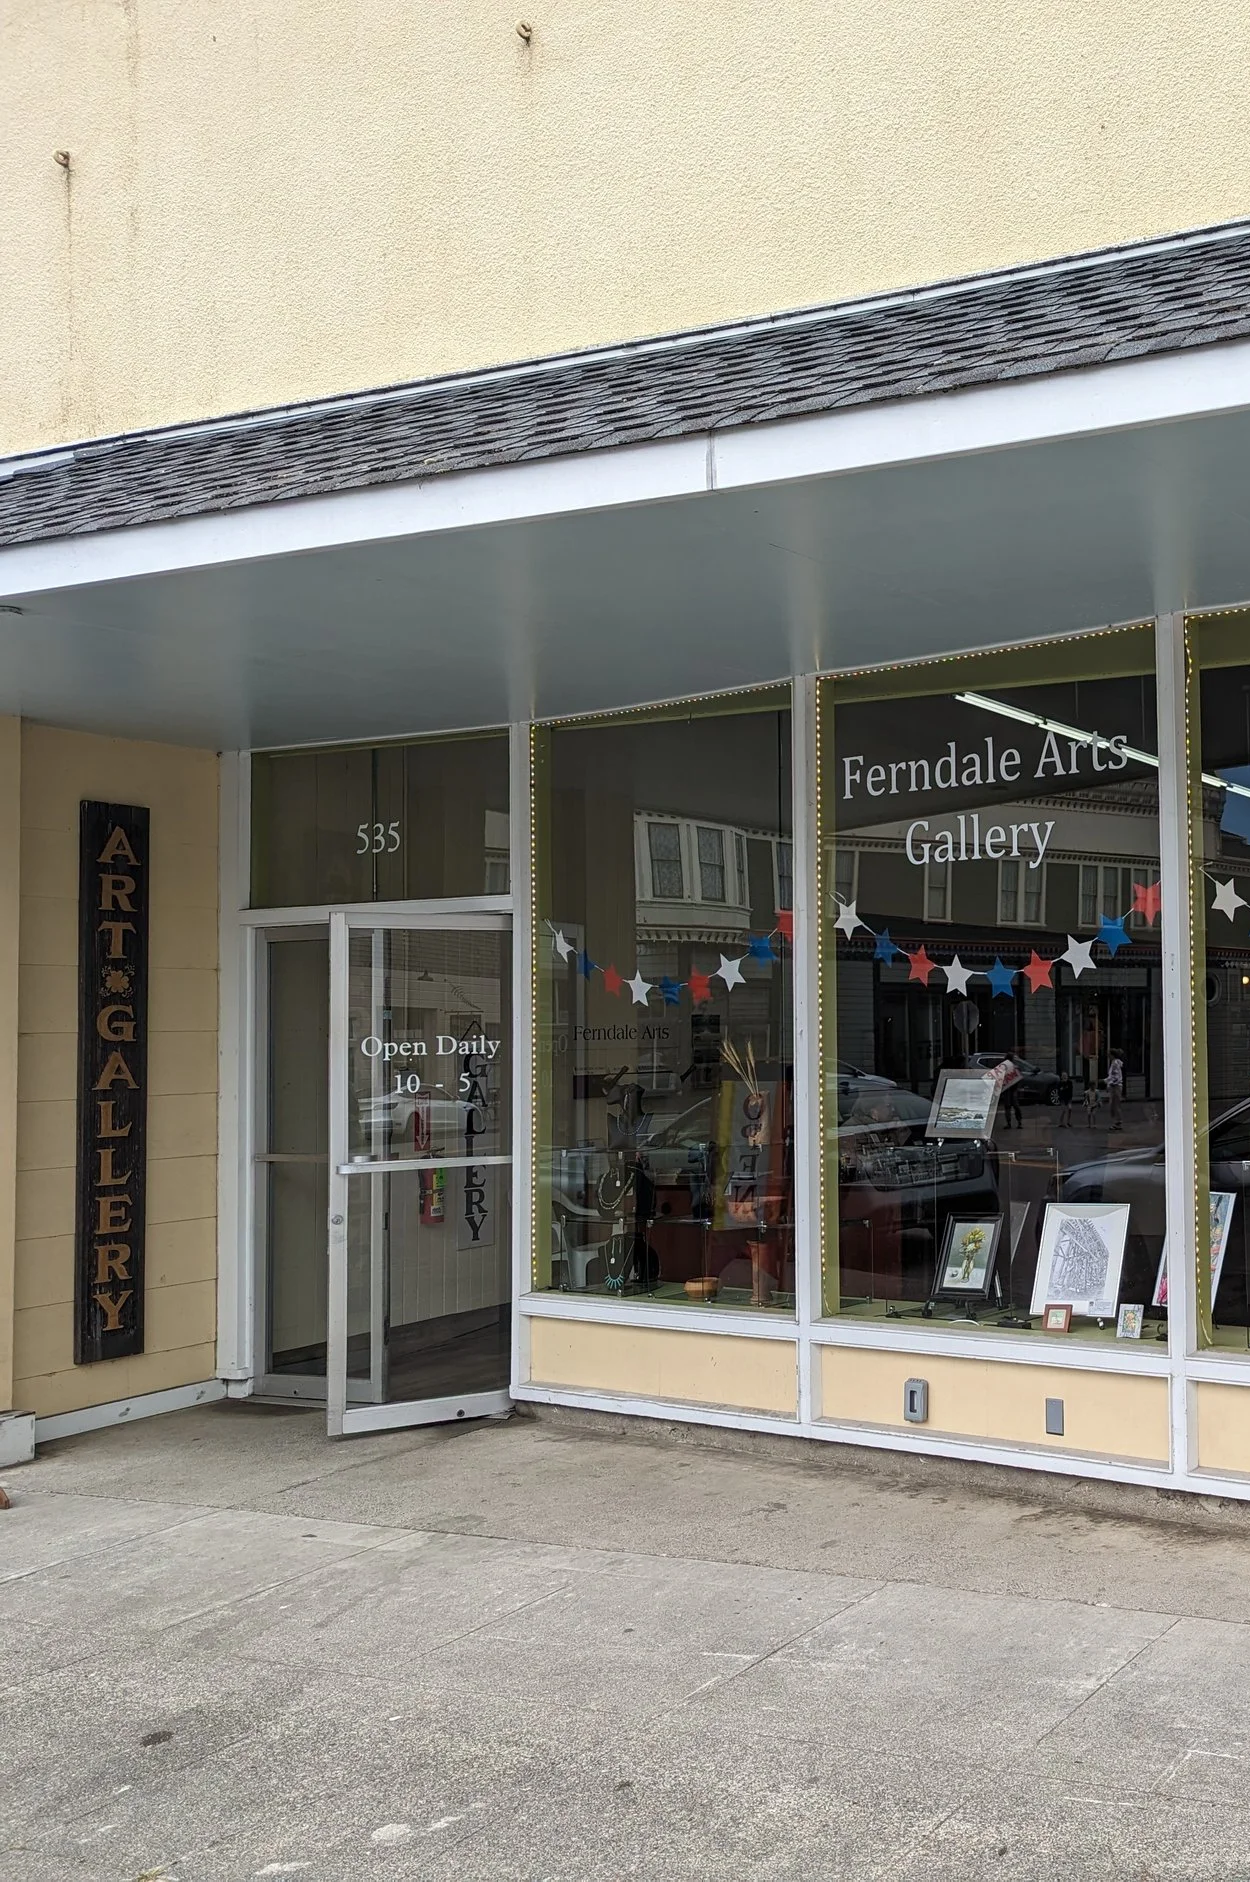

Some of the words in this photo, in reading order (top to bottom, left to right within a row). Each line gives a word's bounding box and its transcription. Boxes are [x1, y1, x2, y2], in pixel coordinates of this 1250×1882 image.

[842, 737, 1021, 800] Ferndale
[1034, 730, 1129, 778] Arts
[356, 821, 400, 854] 535
[905, 814, 1056, 869] Gallery
[95, 826, 142, 959] ART
[361, 1036, 428, 1061] Open
[436, 1035, 501, 1058] Daily
[572, 1024, 637, 1041] Ferndale
[641, 1024, 670, 1040] Arts
[394, 1074, 421, 1094] 10
[459, 1072, 471, 1092] 5
[91, 1004, 140, 1332] GALLERY
[463, 1053, 488, 1241] GALLERY
